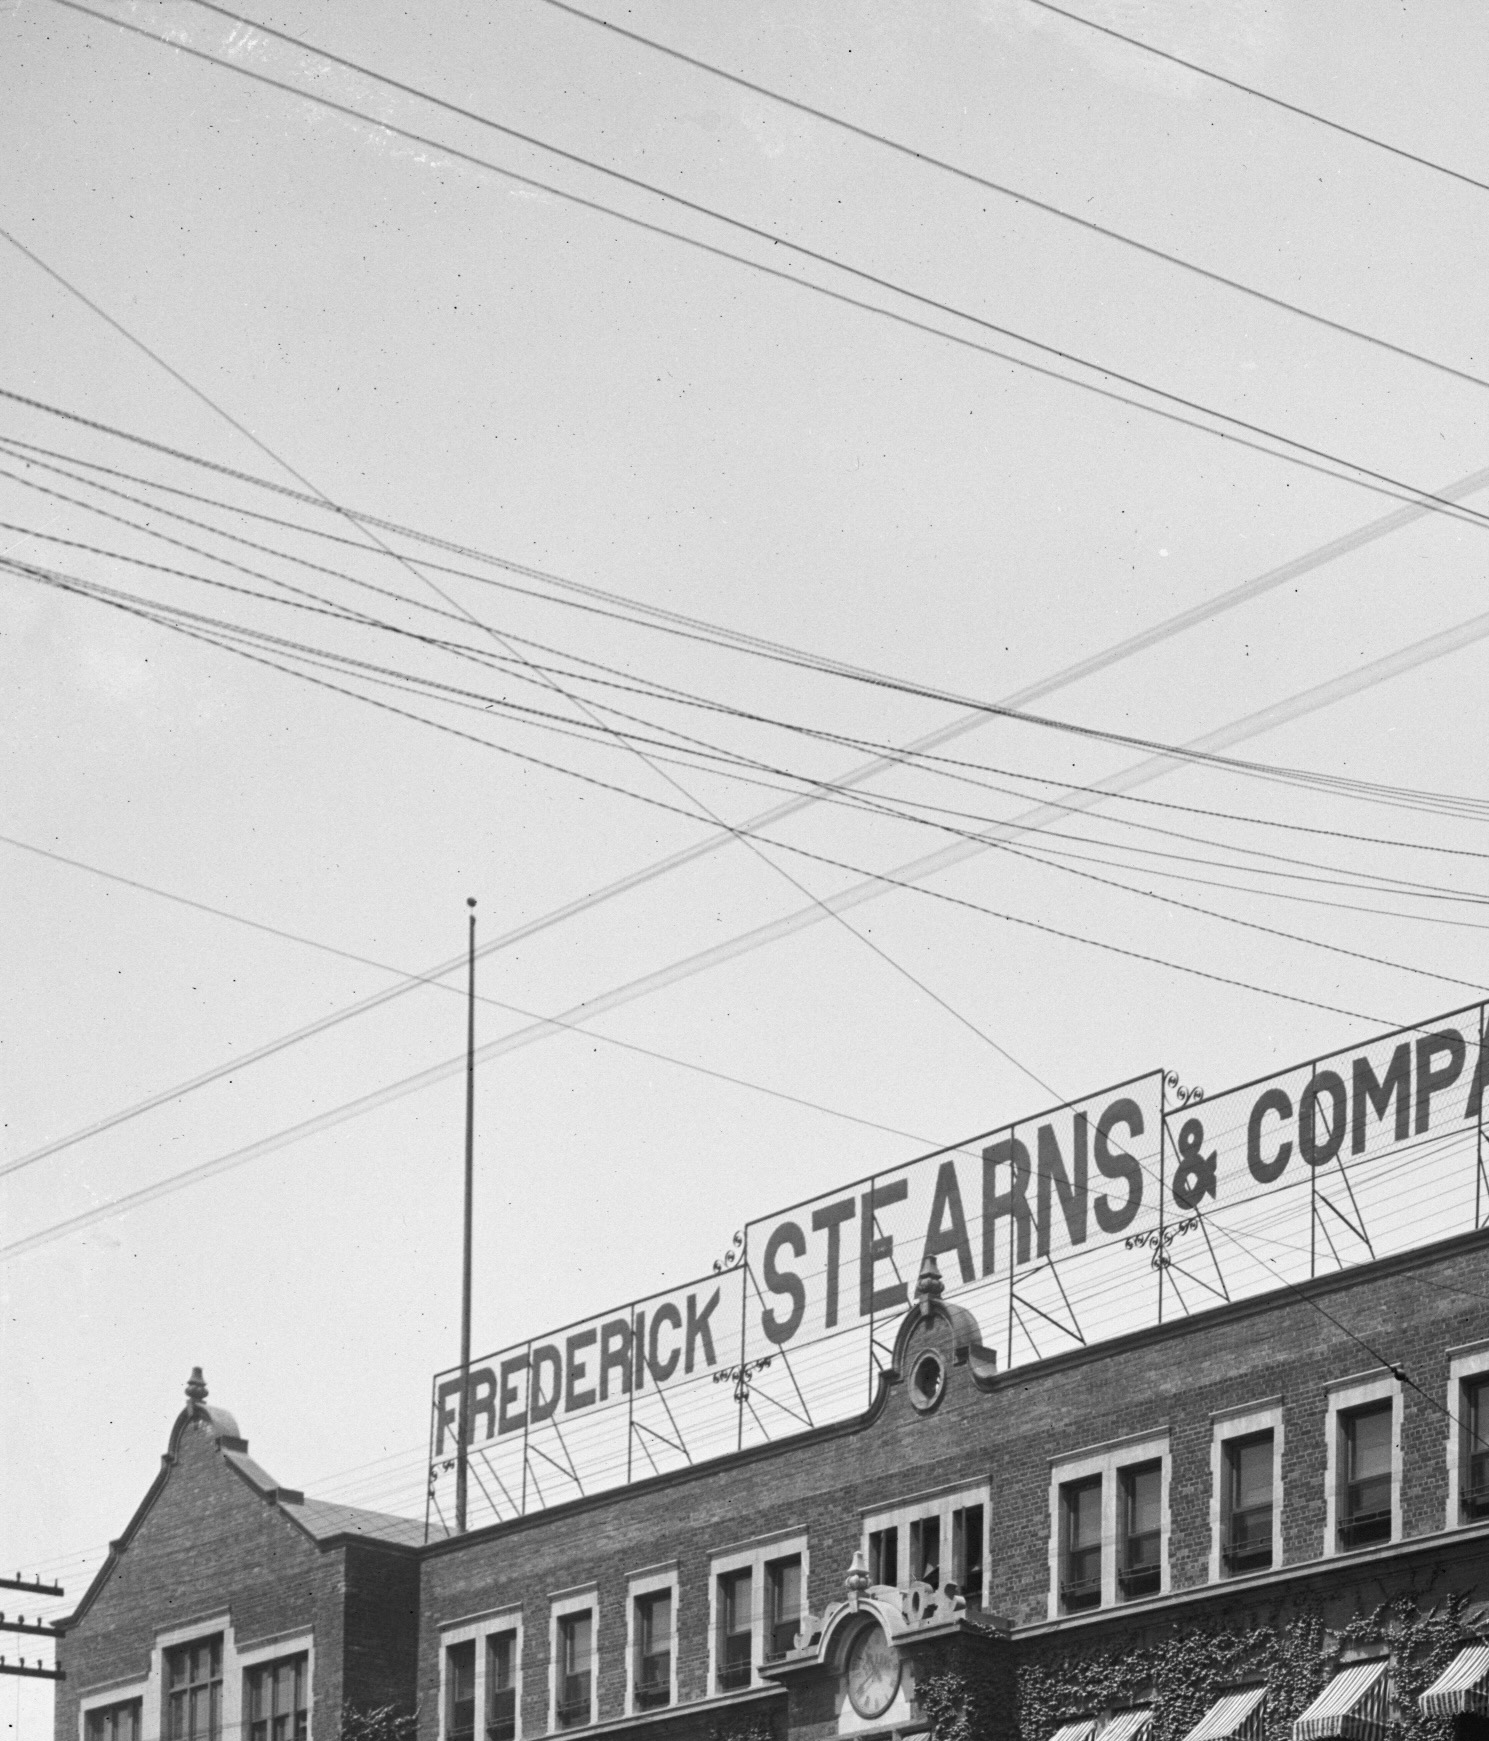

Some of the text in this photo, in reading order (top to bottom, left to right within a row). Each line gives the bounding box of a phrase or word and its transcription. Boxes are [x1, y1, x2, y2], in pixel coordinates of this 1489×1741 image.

[435, 1286, 720, 1456] FREDERICK
[761, 1097, 1145, 1345] STEARNS
[1172, 1118, 1217, 1210] &
